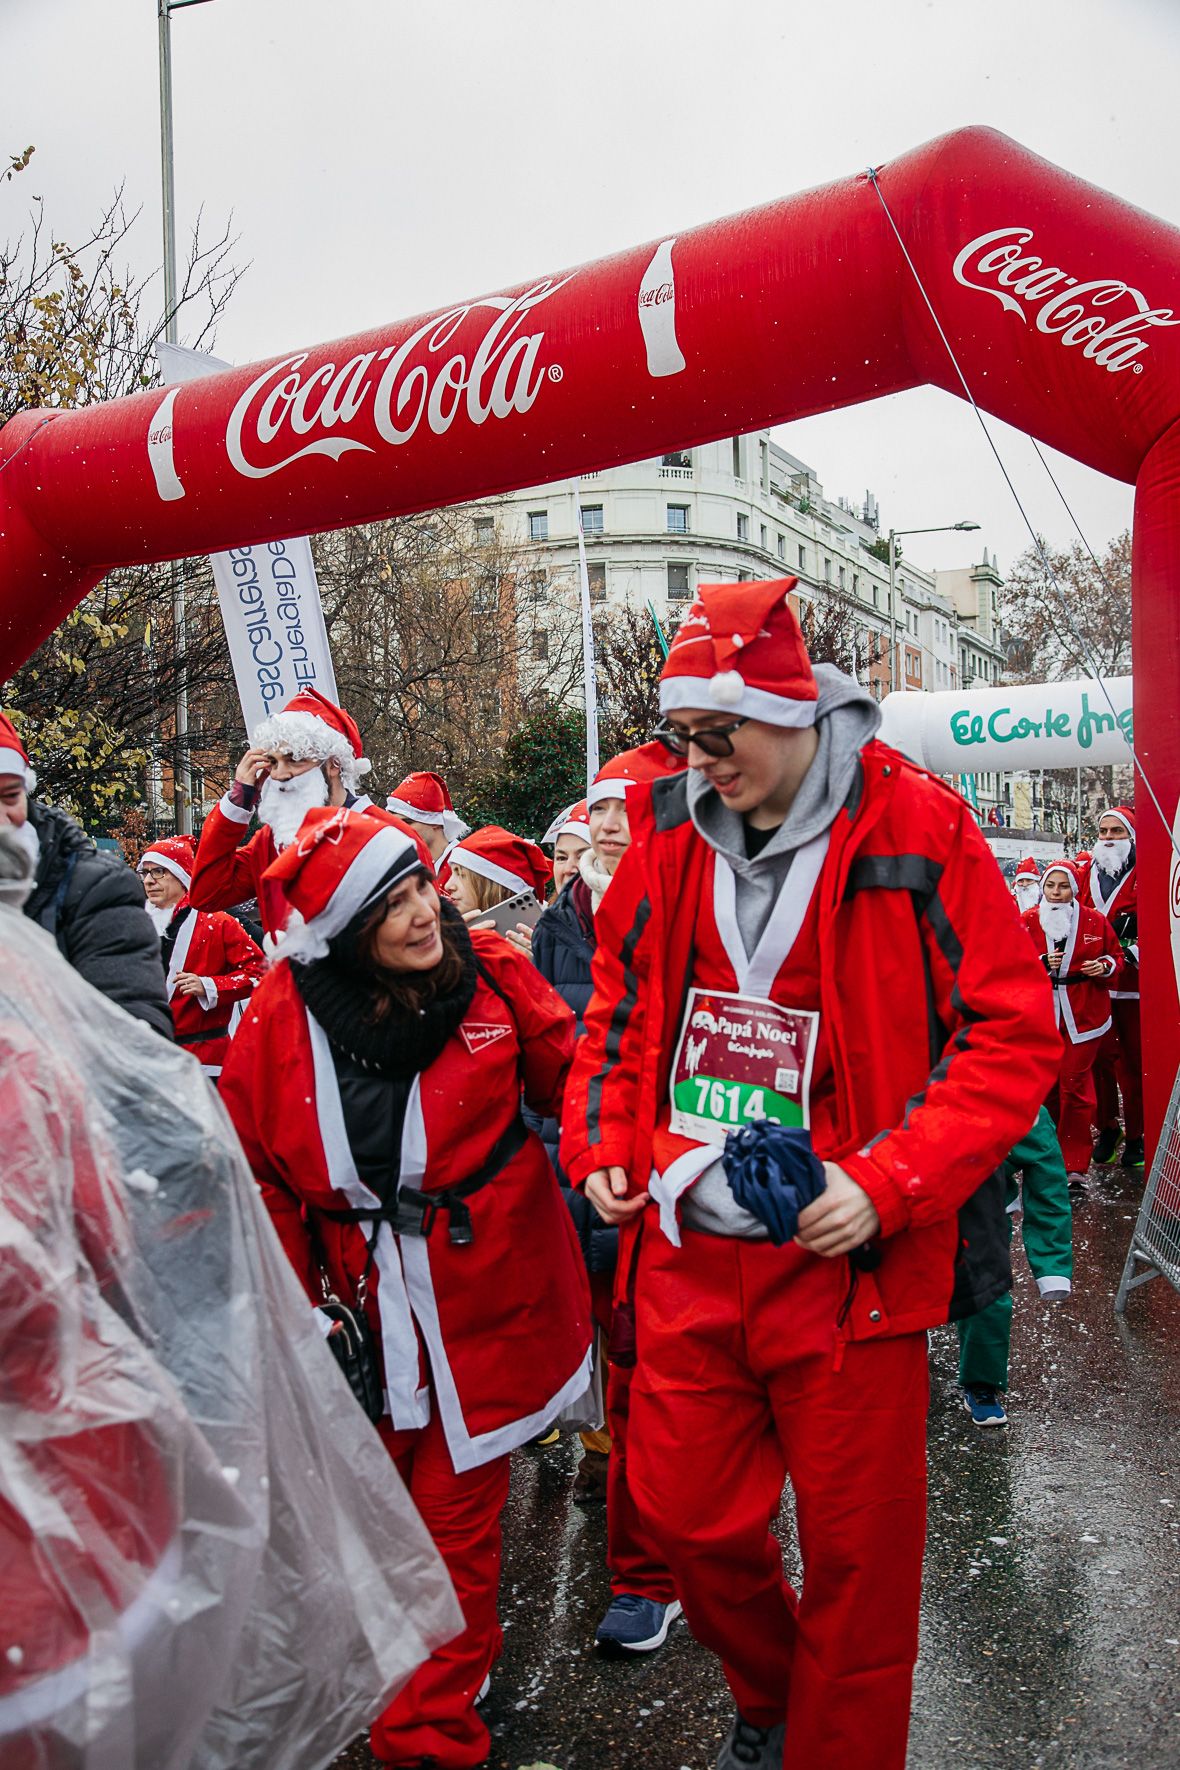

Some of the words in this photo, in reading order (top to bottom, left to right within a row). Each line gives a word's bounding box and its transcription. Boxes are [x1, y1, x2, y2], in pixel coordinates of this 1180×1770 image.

[950, 710, 986, 746] El
[987, 707, 1072, 743] Corte
[1077, 692, 1134, 749] Ing
[756, 1022, 797, 1046] Noel
[694, 1078, 767, 1122] 7614
